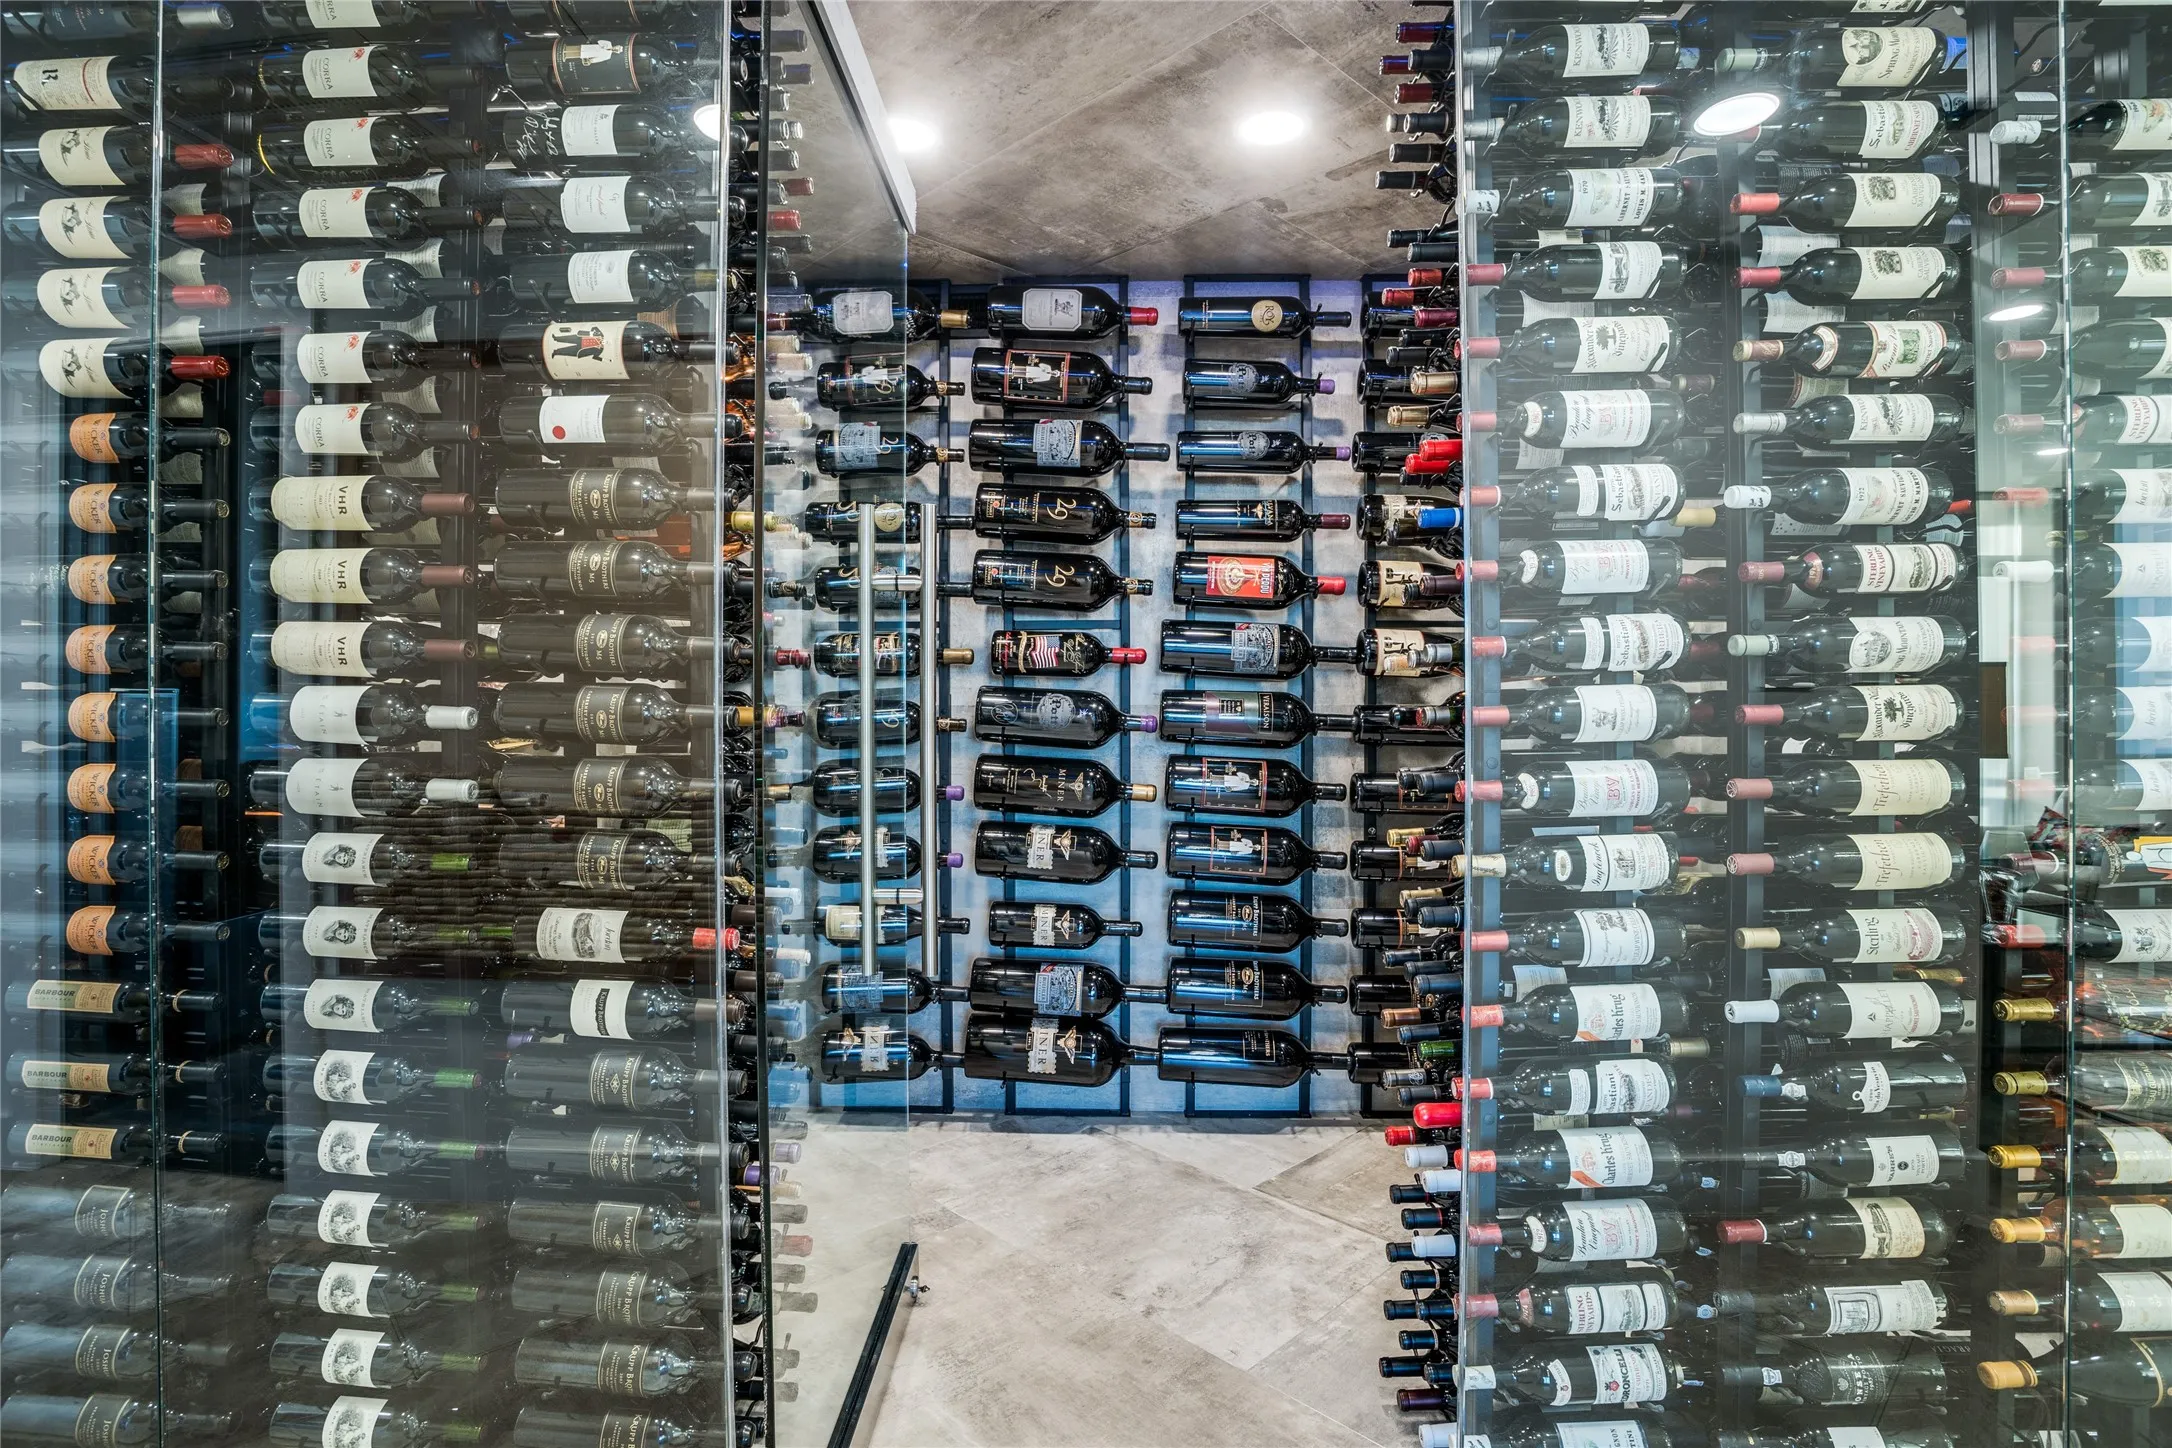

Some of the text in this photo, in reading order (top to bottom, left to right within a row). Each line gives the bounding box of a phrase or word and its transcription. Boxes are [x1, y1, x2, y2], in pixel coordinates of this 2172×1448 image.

[322, 57, 333, 90] CORRA
[1878, 48, 1900, 79] SPRING
[324, 128, 335, 160] CORRA
[1905, 120, 1920, 150] CABERNET
[319, 200, 330, 231] CORRA
[1634, 198, 1645, 219] LOUIS
[317, 271, 328, 303] CORRA
[1263, 305, 1274, 325] ROY
[317, 346, 329, 378] CORRA
[314, 417, 325, 448] CORRA
[2128, 399, 2141, 437] STERLING
[2136, 398, 2151, 439] VINEYARDS
[91, 419, 103, 454] WICKER
[602, 474, 613, 493] KRUPP
[1892, 469, 1906, 497] SAUVIGNON
[1908, 470, 1920, 494] MARTINI
[90, 490, 102, 524] WICKER
[338, 486, 348, 515] VHR
[1046, 498, 1077, 521] 29
[90, 561, 101, 596] WICKER
[337, 560, 348, 590] VHR
[601, 556, 610, 590] BROTHERS
[1045, 565, 1075, 588] 29
[1260, 562, 1271, 572] VIN
[1865, 548, 1877, 586] STERLING
[1875, 546, 1886, 588] VINEYARDS
[87, 632, 101, 666] WICKER
[336, 636, 348, 666] VHR
[609, 633, 617, 667] BROTHERS
[1615, 619, 1630, 666] Sebastiani
[1895, 620, 1909, 654] MOUNTAIN
[89, 701, 101, 735] WICKER
[609, 693, 619, 714] KRUPP
[1897, 692, 1916, 728] Vineyards
[88, 772, 101, 807] WICKER
[607, 766, 617, 787] KRUPP
[1057, 769, 1066, 801] MINER
[1605, 776, 1620, 800] BV
[1863, 764, 1901, 811] Trefethen
[1036, 832, 1045, 861] INER
[1864, 839, 1902, 886] Trefethen
[88, 847, 101, 880] WICKER
[609, 840, 620, 889] KRUPP BROTHERS
[1589, 842, 1605, 886] Inglenook
[88, 916, 101, 950] WICKER
[603, 926, 616, 951] Jordan
[1041, 909, 1049, 940] MINER
[1864, 917, 1880, 955] Sterling
[35, 988, 75, 997] BARBOUR
[598, 991, 607, 1011] KRUPP
[1610, 994, 1625, 1017] Krug
[1039, 1032, 1049, 1064] INER
[27, 1070, 67, 1078] BARBOUR
[623, 1057, 635, 1078] KRUPP
[32, 1134, 72, 1143] BARBOUR
[622, 1134, 634, 1156] KRUPP
[1596, 1133, 1616, 1184] Charles Krug
[624, 1216, 634, 1239] KRUPP
[1575, 1218, 1588, 1257] Beaulieu
[1582, 1210, 1600, 1251] Vineyard
[100, 1273, 111, 1305] JOSHUA
[626, 1271, 641, 1296] KRUPP
[628, 1344, 641, 1371] KRUPP
[1847, 1353, 1863, 1402] ONSECA
[629, 1414, 642, 1442] KRUPP
